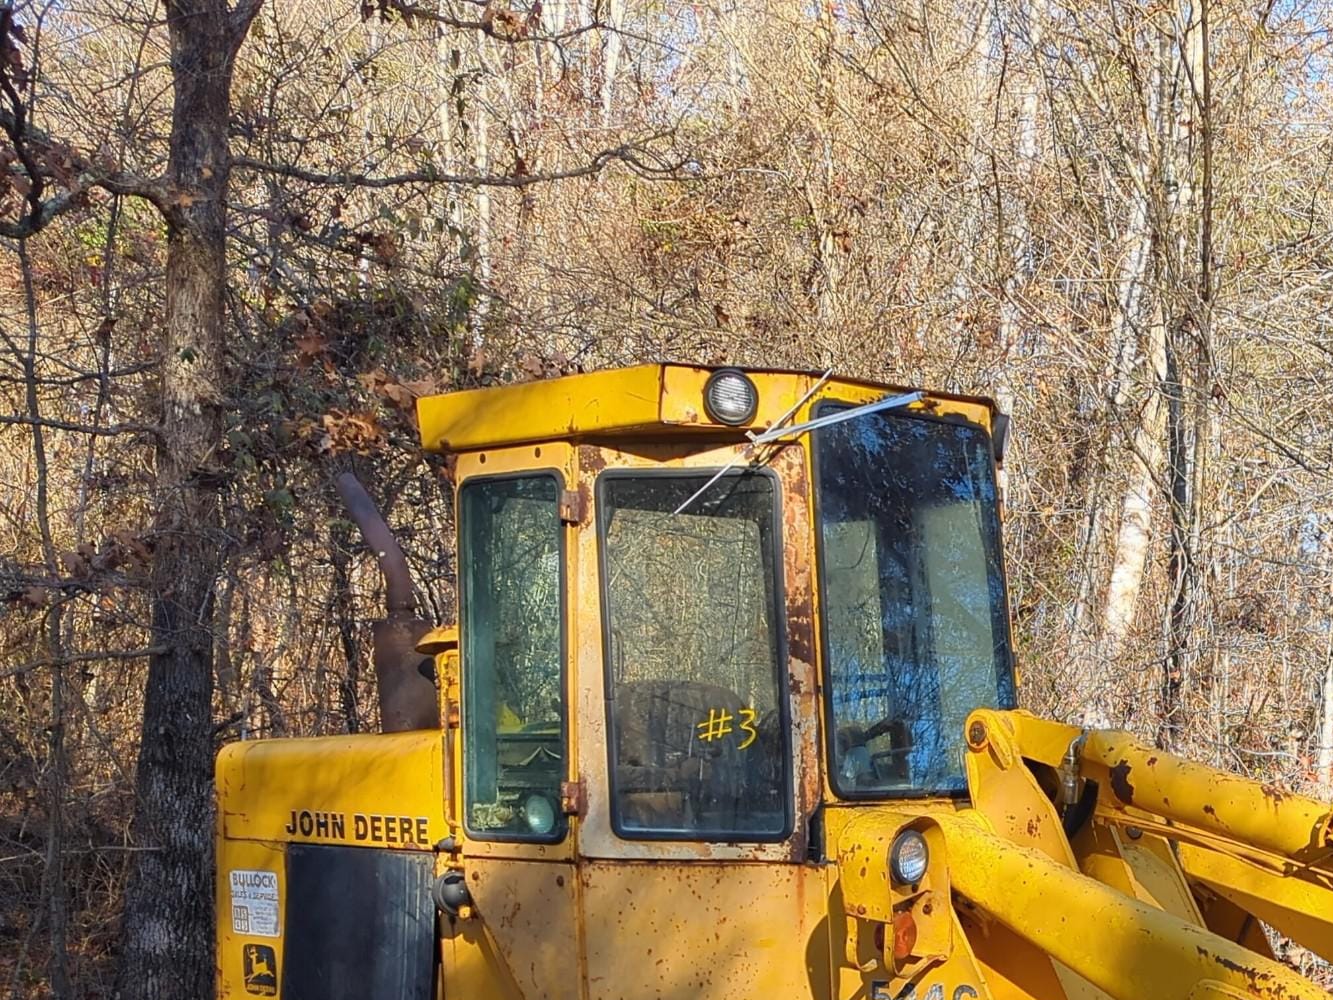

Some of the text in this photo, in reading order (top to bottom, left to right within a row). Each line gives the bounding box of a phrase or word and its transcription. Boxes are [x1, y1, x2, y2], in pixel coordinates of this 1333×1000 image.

[697, 708, 756, 749] #3
[286, 810, 428, 844] JOHN DEERE
[233, 873, 275, 888] BULLOCK
